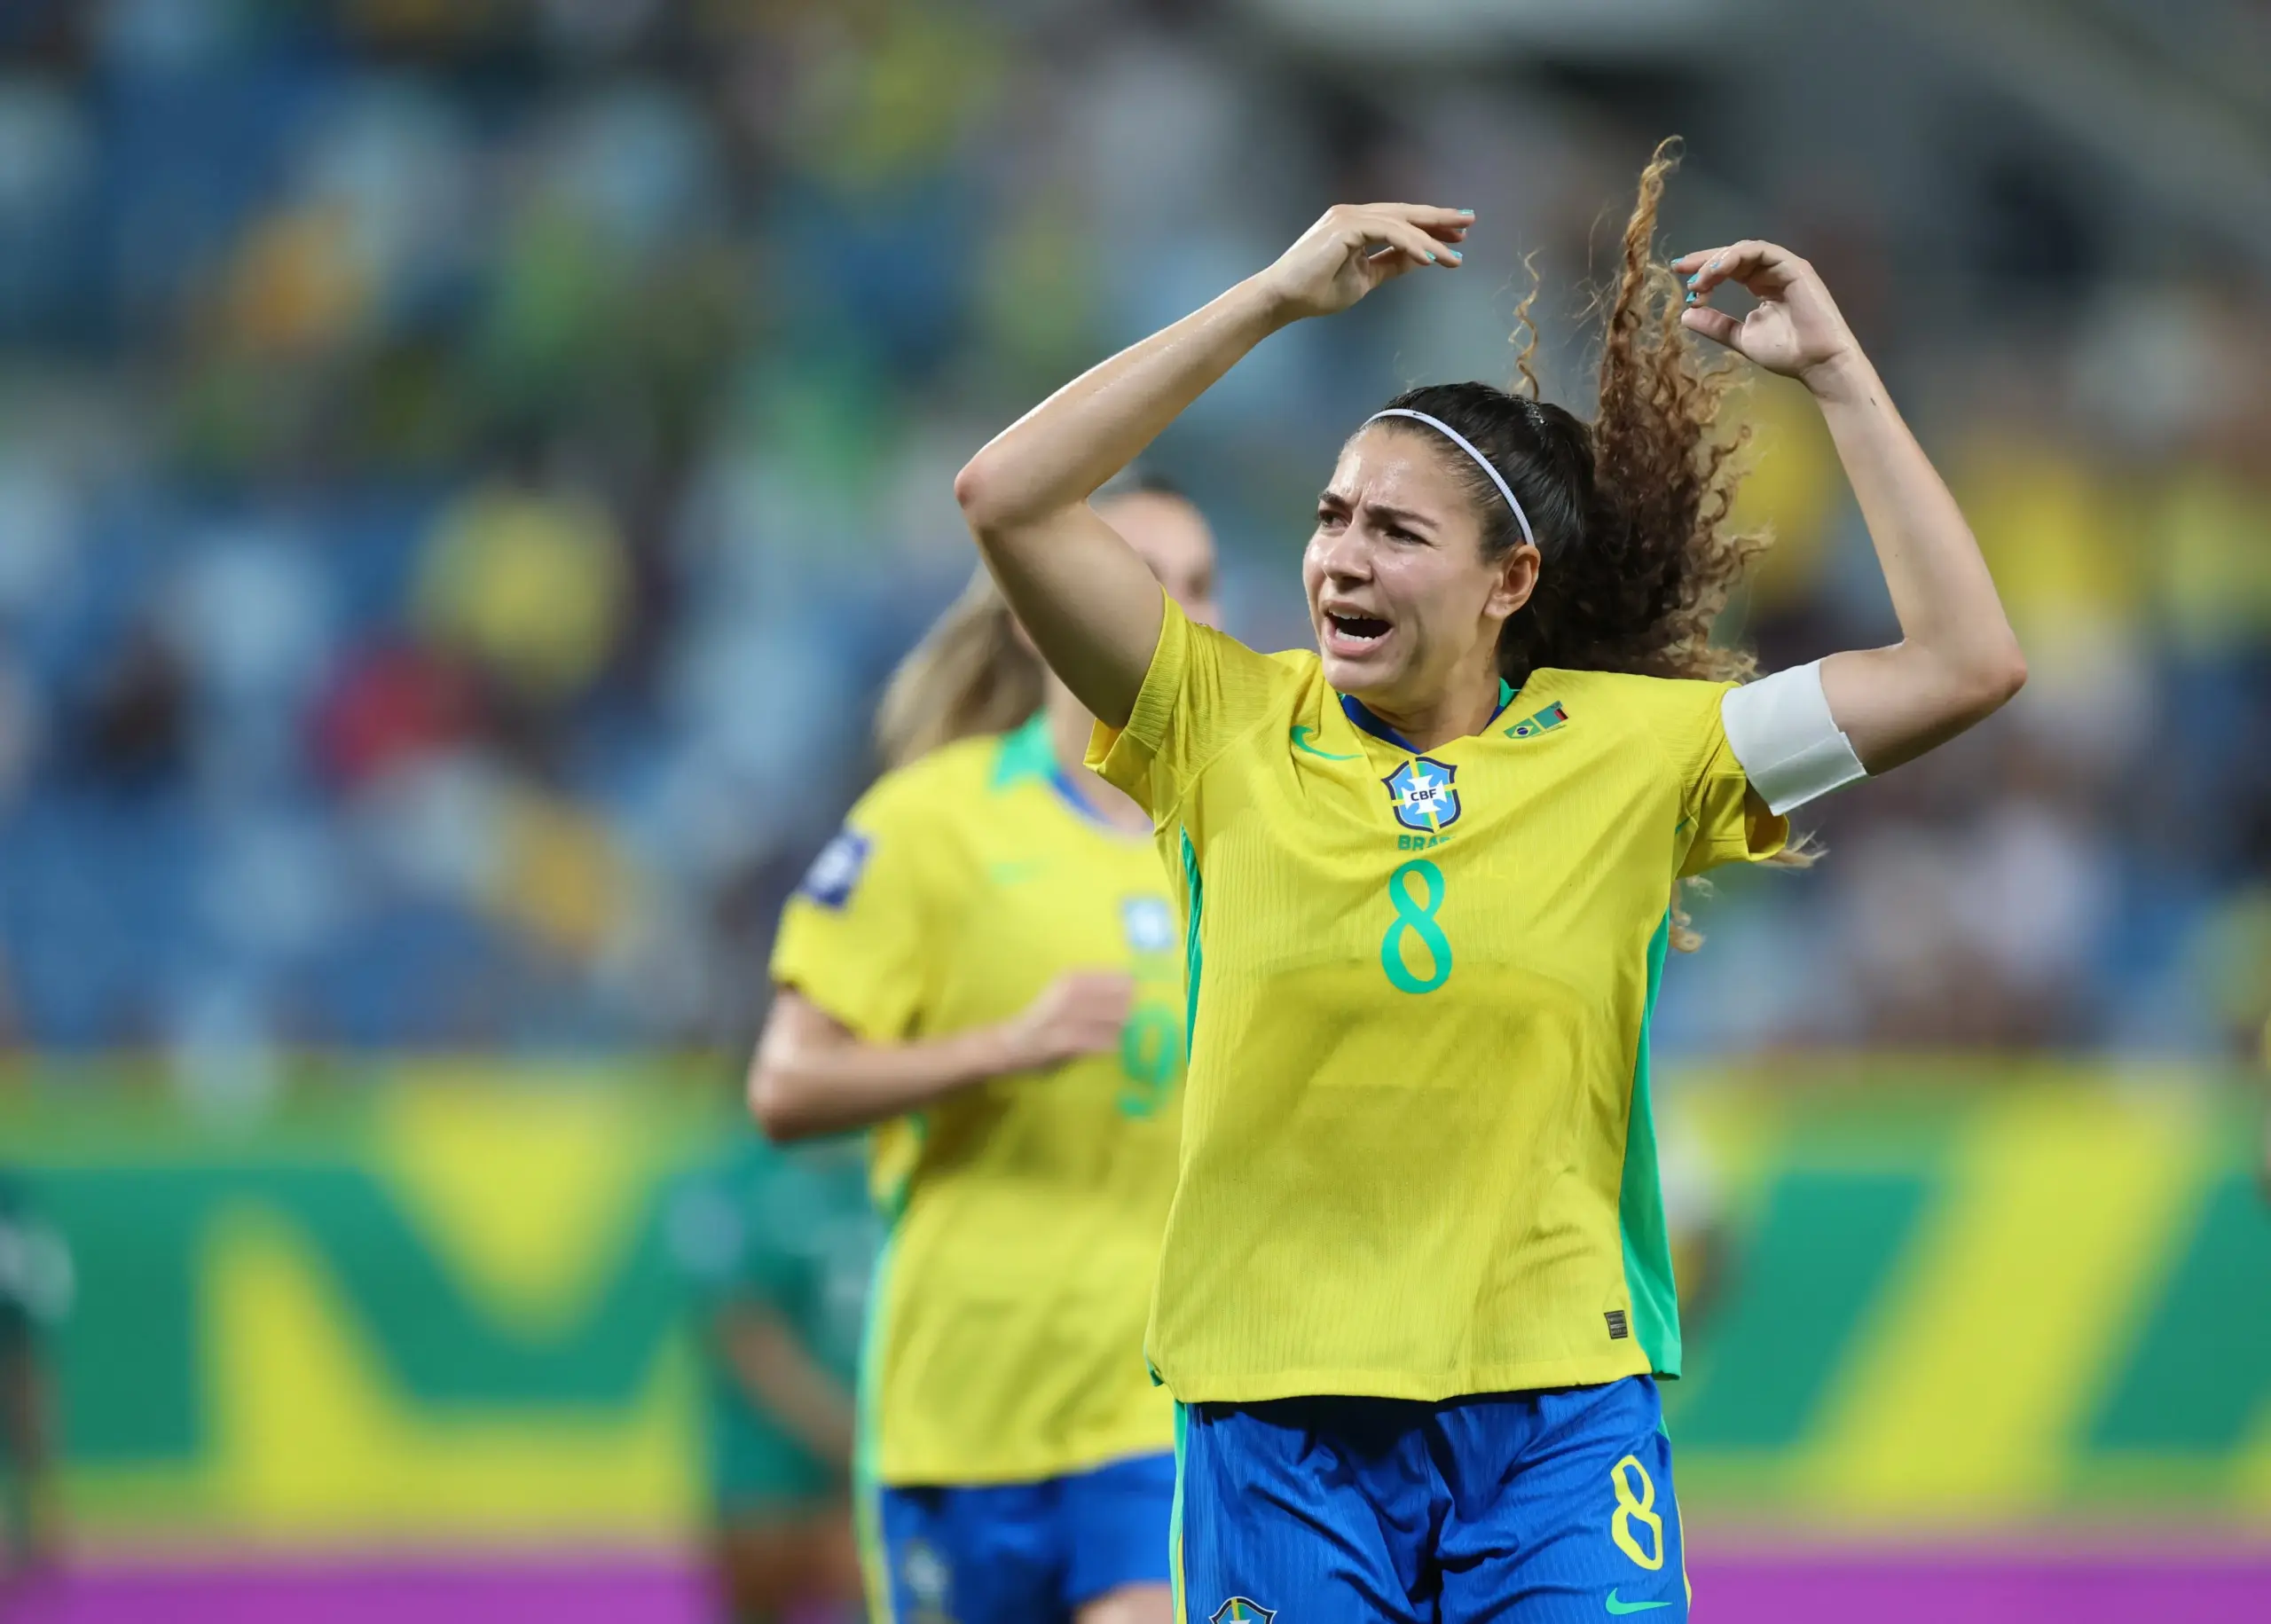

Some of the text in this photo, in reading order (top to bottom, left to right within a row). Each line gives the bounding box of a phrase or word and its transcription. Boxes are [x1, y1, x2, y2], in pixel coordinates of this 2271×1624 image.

[1411, 788, 1436, 801] CBF
[1381, 859, 1452, 994] 8
[1120, 1002, 1180, 1119] 9
[1610, 1455, 1663, 1571] 8
